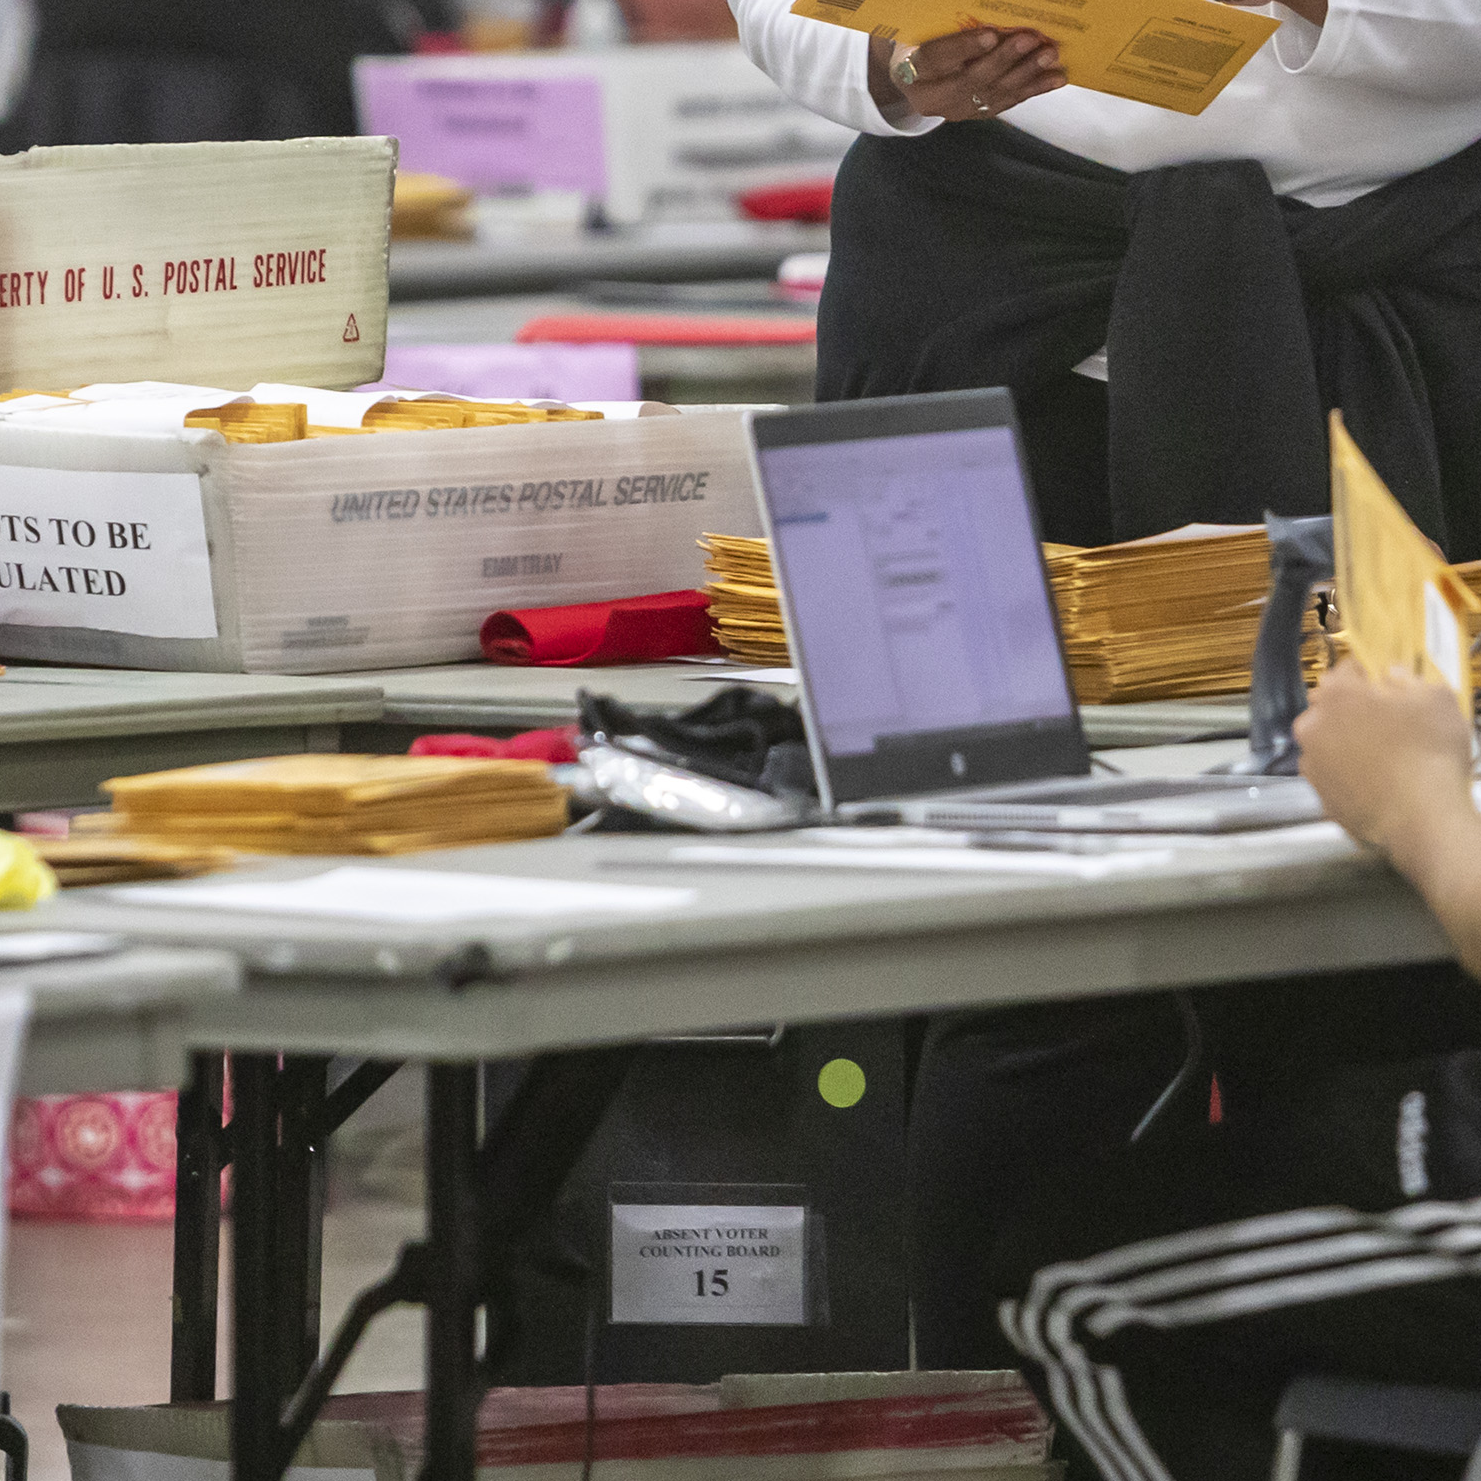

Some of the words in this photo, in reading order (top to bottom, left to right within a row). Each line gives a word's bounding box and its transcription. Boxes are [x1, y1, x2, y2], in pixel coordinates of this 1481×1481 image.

[64, 268, 87, 302] OF
[163, 257, 238, 295] POSTAL
[253, 248, 327, 288] SERVICE
[331, 489, 420, 524] UNITED
[426, 483, 514, 518] STATES
[518, 478, 607, 513] POSTAL
[614, 471, 710, 507] SERVICE
[49, 518, 96, 548] TO
[106, 521, 151, 550] BE
[652, 1229, 711, 1240] ABSENT
[713, 1227, 768, 1240] VOTER
[639, 1245, 722, 1258] COUNTING
[726, 1245, 781, 1257] BOARD
[694, 1269, 730, 1297] 15
